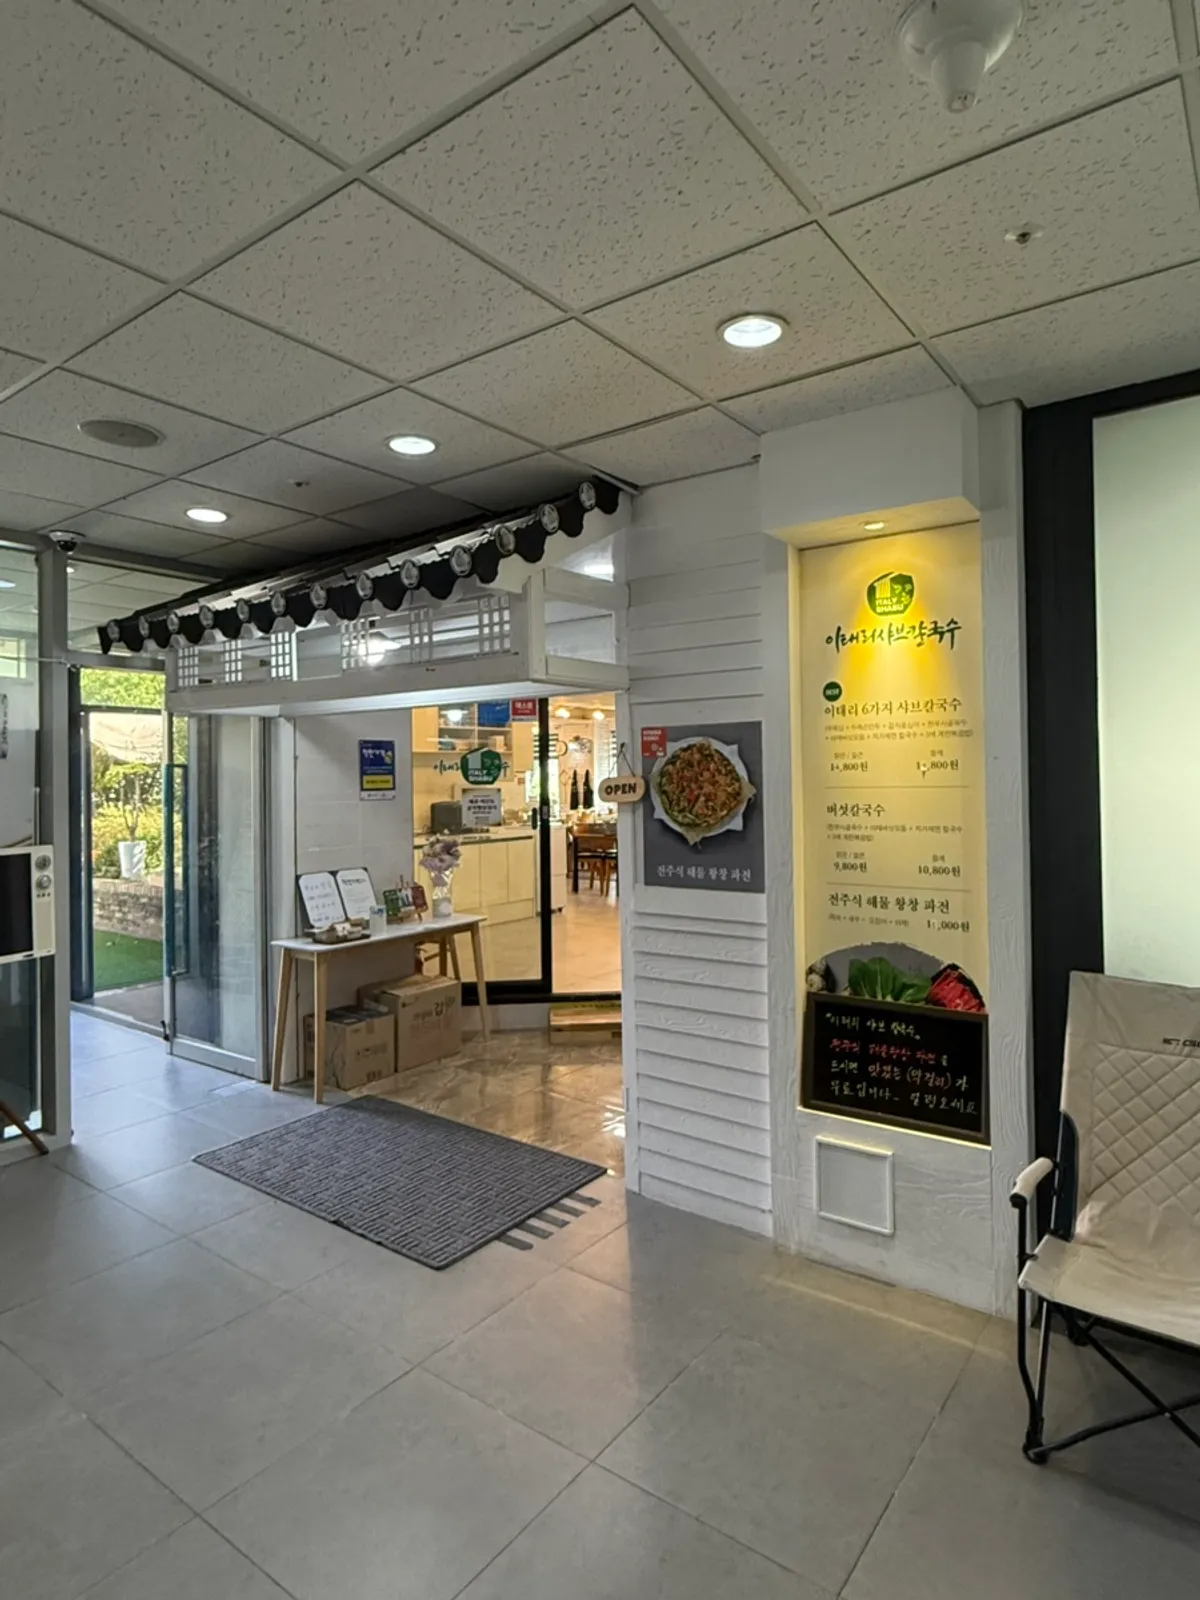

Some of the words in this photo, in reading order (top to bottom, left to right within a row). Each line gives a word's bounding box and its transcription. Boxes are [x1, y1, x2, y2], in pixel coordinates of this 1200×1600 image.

[824, 703, 859, 717] 이태리
[861, 700, 893, 715] 6가지
[897, 698, 962, 714] 샤브칼국수
[916, 759, 959, 771] 1,800원
[604, 782, 638, 796] OPEN
[826, 803, 886, 818] 버섯칼국수
[657, 865, 684, 878] 전주식
[731, 869, 751, 883] 파전
[833, 862, 867, 873] 9,800원
[918, 865, 961, 878] 10,800원
[828, 893, 863, 909] 전주식
[866, 895, 889, 910] 해물
[894, 896, 919, 912] 왕창
[924, 899, 950, 914] 파전
[927, 920, 970, 933] 1,000원
